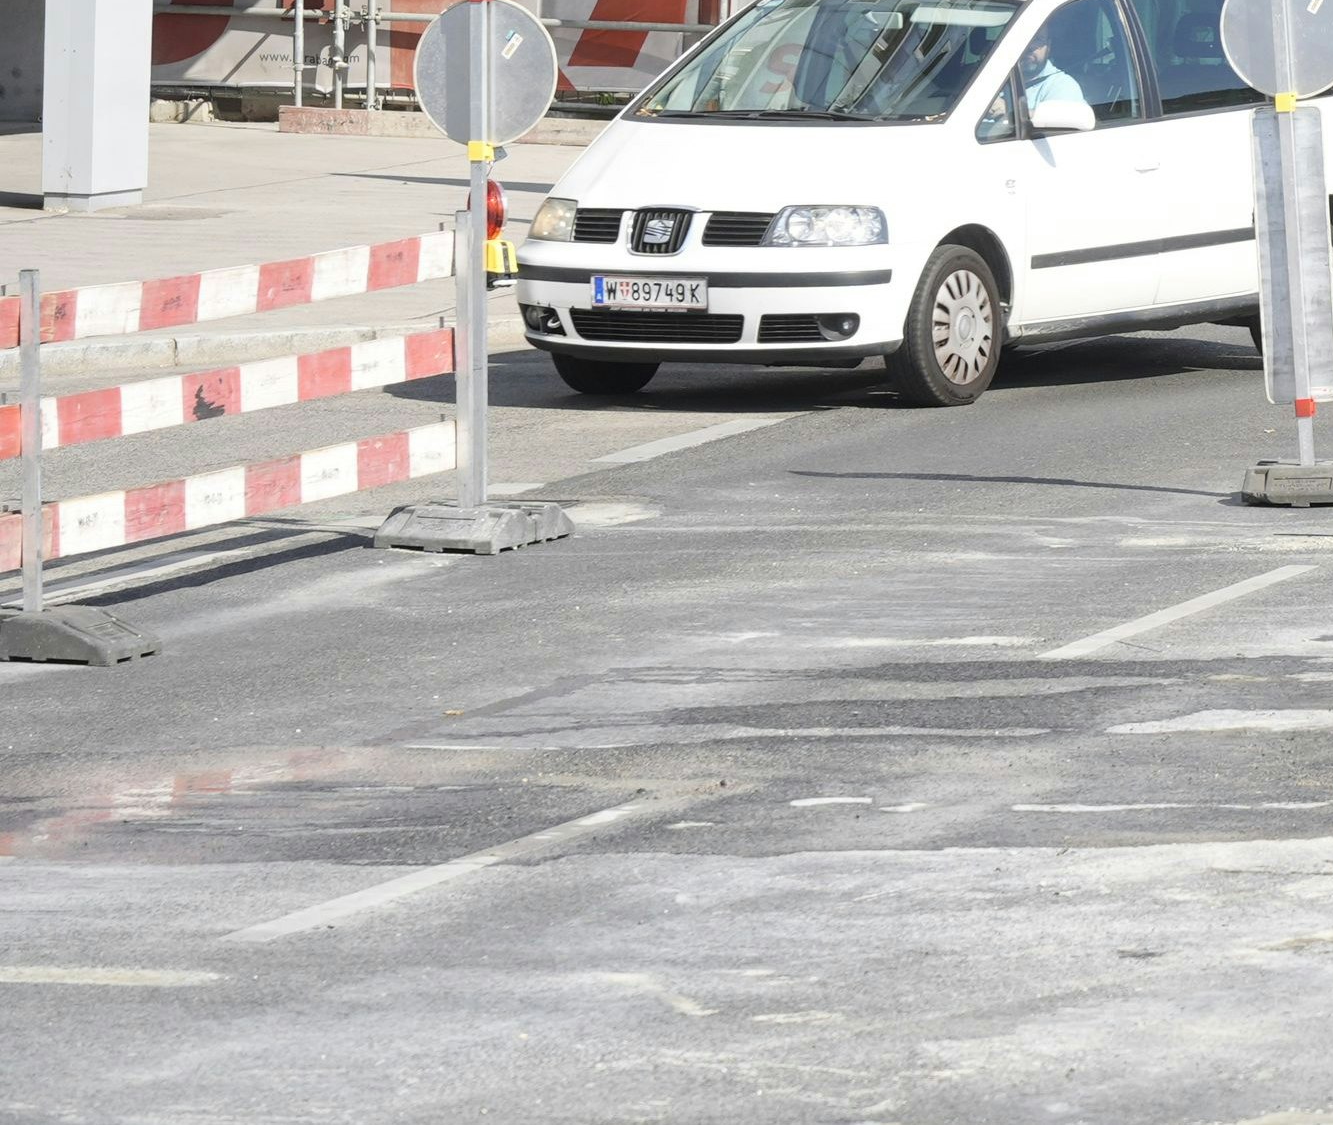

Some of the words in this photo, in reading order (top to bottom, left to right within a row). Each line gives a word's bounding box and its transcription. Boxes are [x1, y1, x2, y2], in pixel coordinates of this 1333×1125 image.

[606, 281, 618, 301] W
[631, 282, 685, 303] 89749
[690, 283, 700, 304] K
